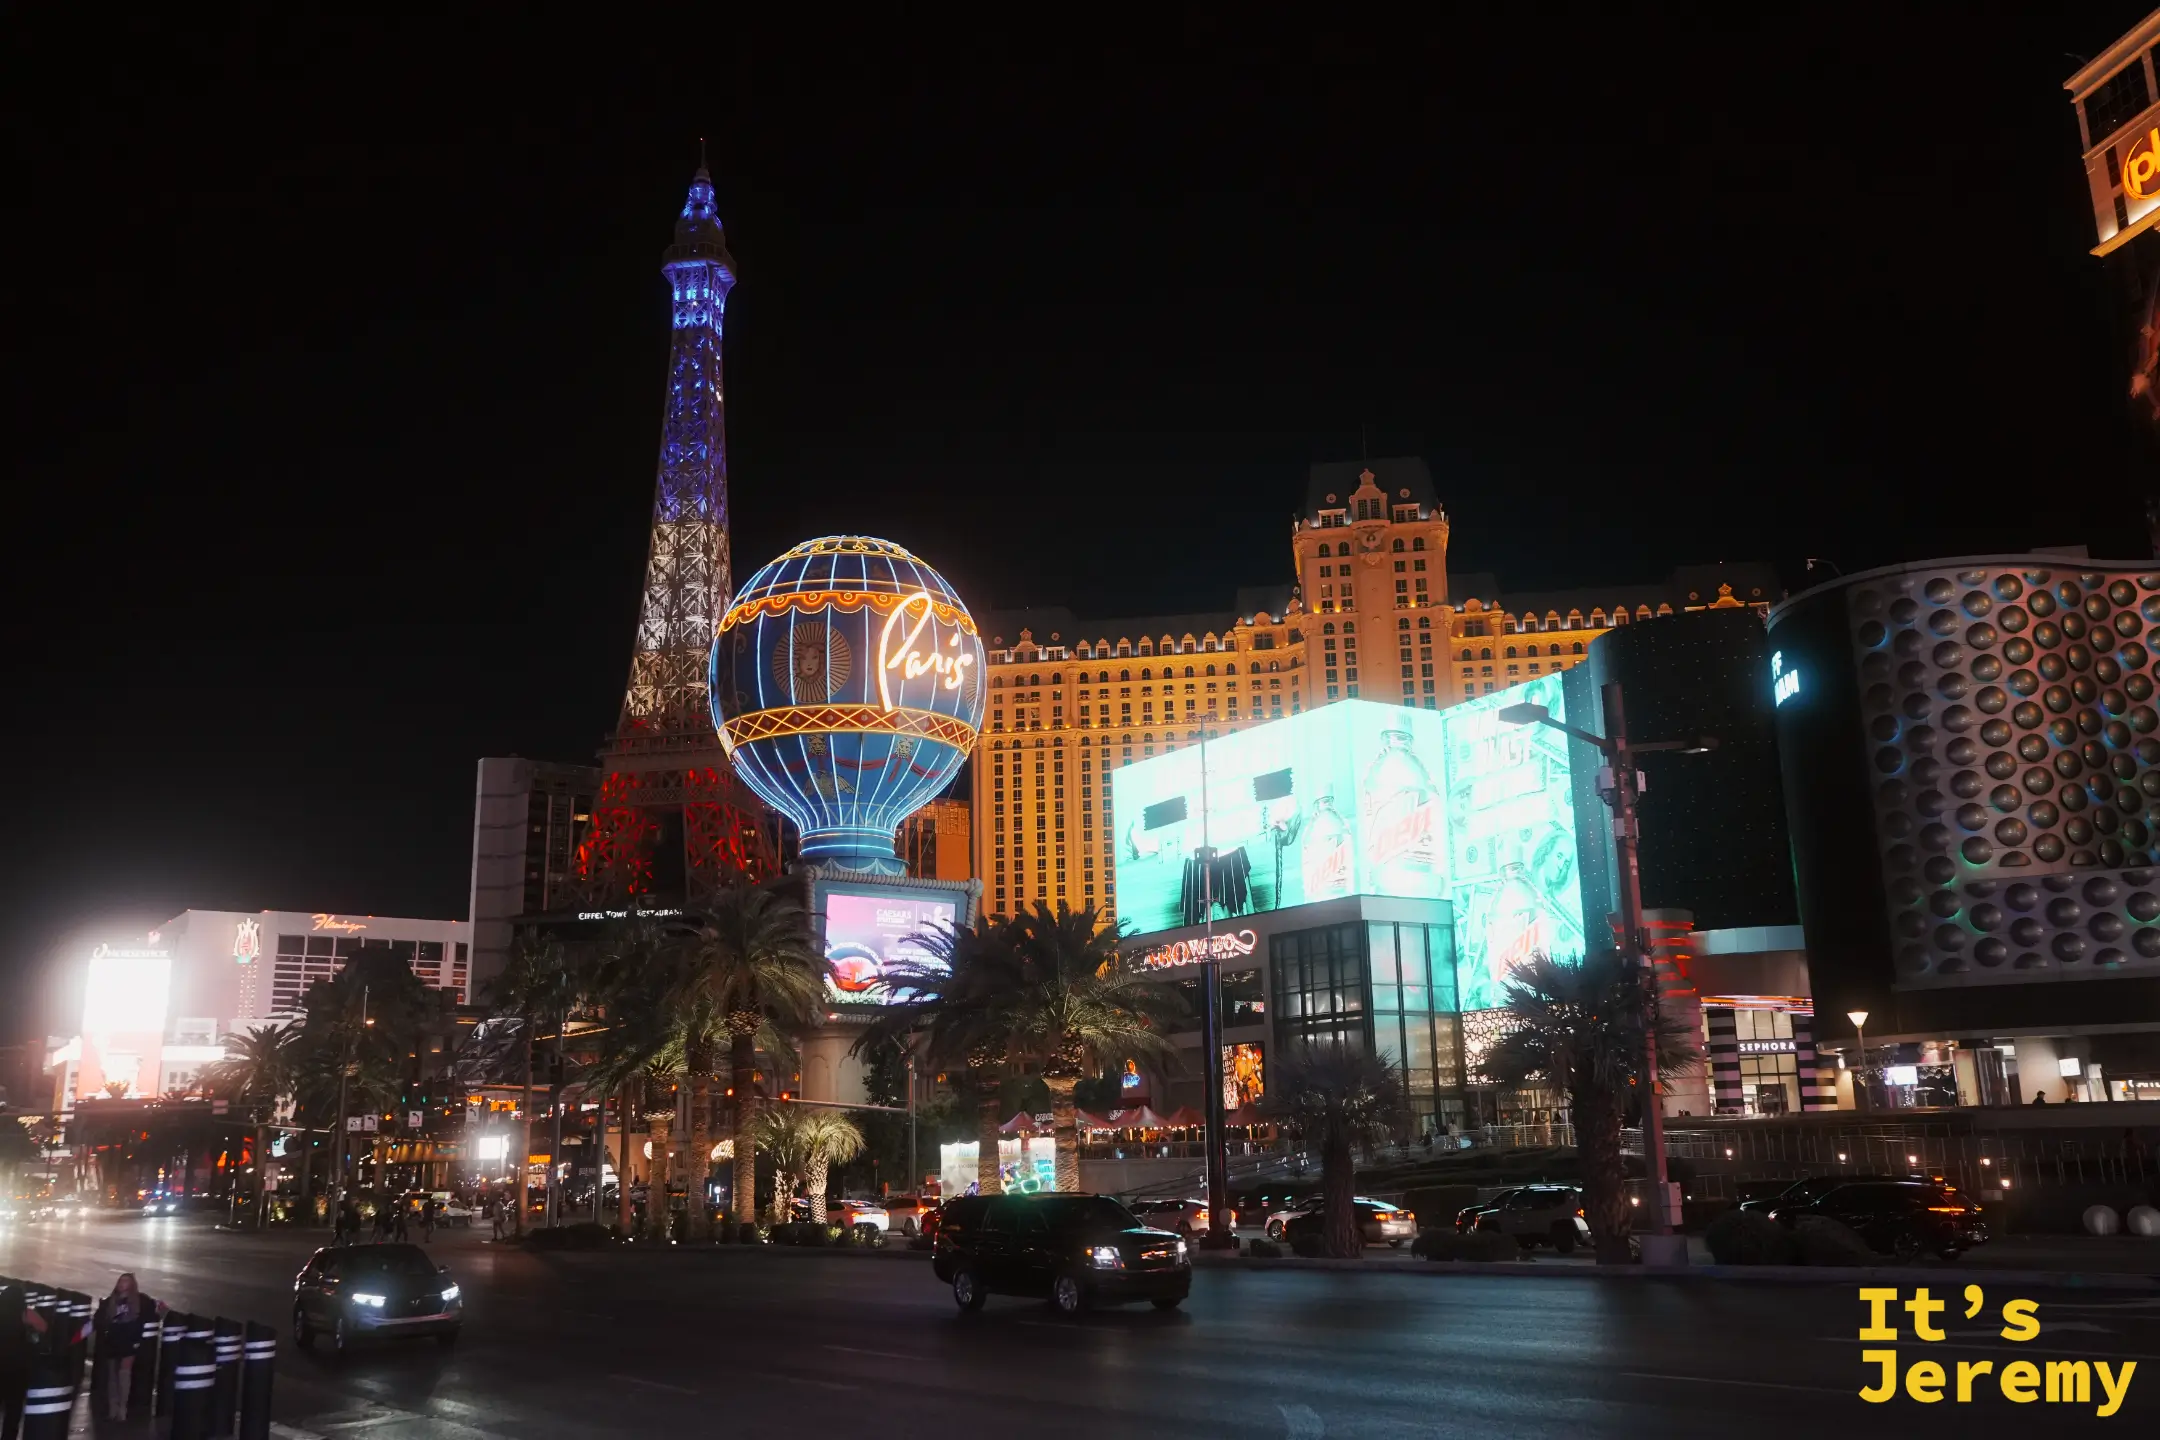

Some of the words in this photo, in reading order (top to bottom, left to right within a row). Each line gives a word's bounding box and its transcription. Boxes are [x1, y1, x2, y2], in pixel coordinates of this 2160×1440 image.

[878, 591, 974, 713] Paris
[579, 912, 604, 920] EIFFEL
[606, 910, 635, 919] TOWE
[311, 913, 367, 934] Flamingo
[1740, 1042, 1796, 1051] SEPHORA
[1223, 1090, 1239, 1104] OCK
